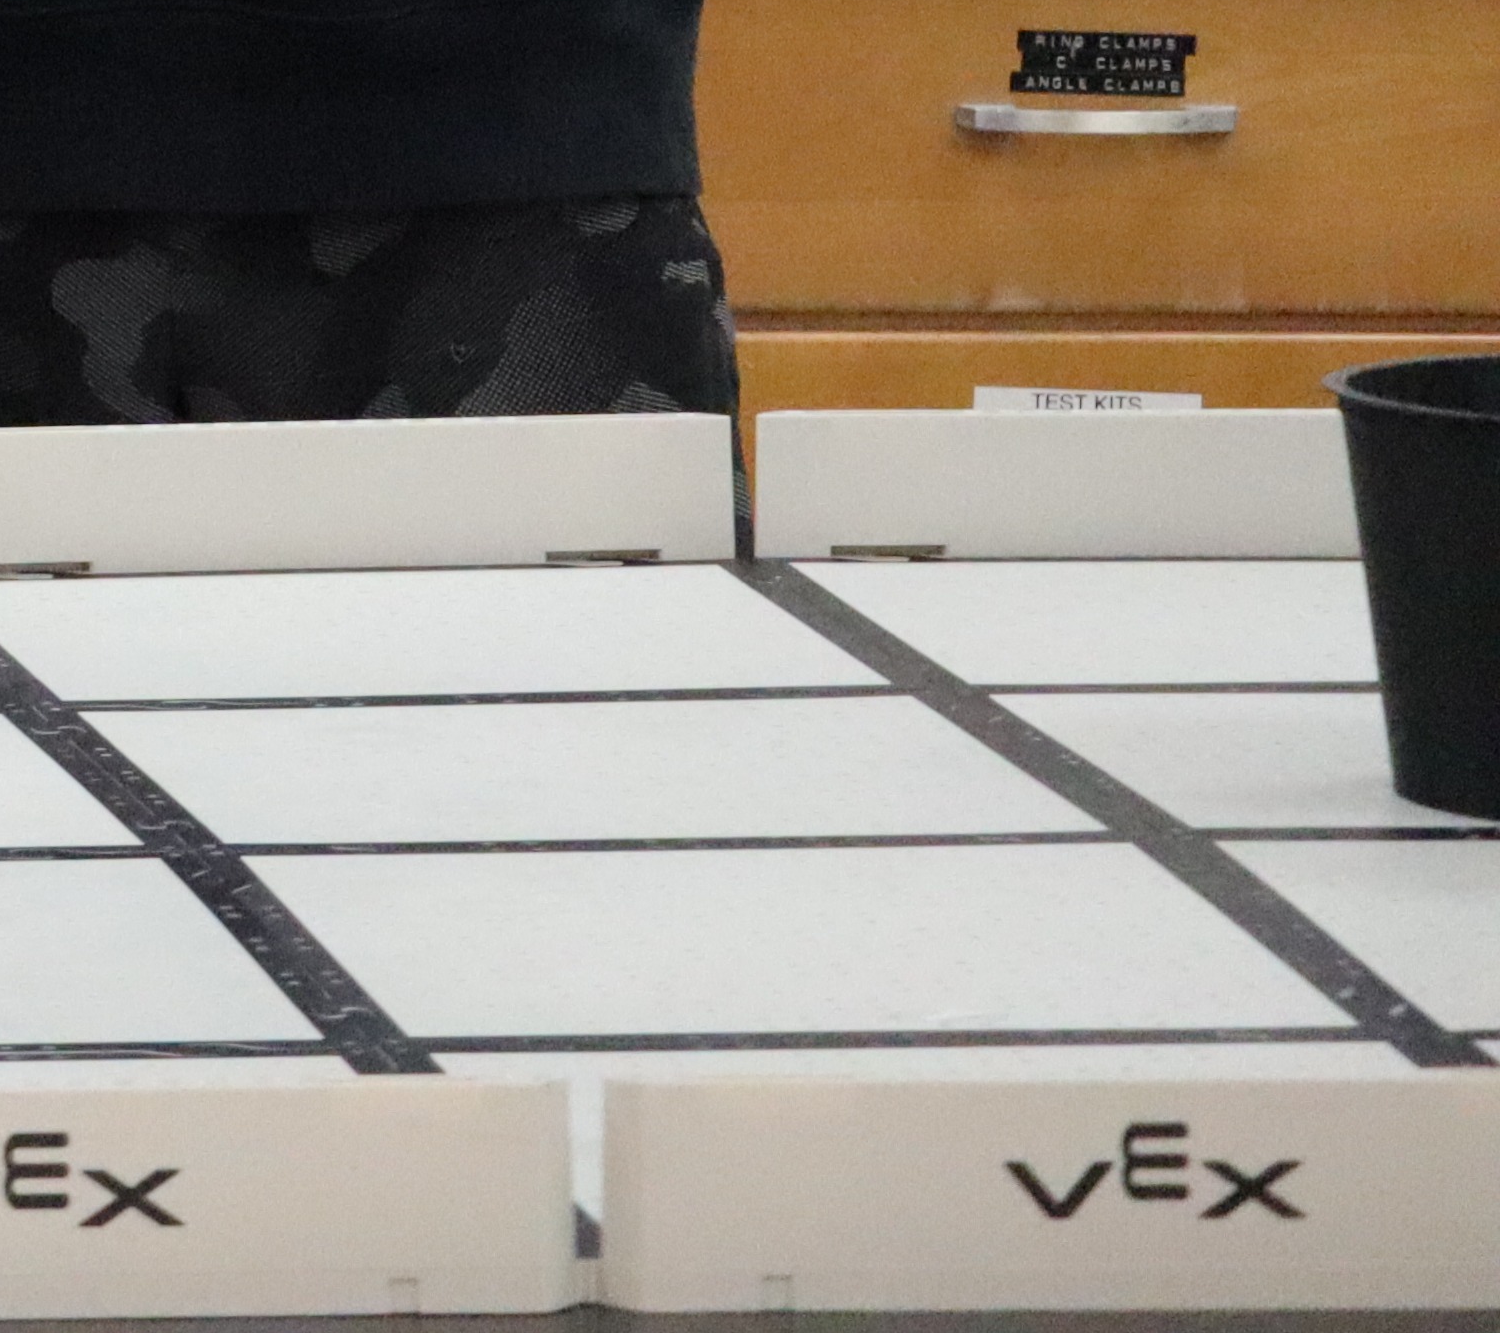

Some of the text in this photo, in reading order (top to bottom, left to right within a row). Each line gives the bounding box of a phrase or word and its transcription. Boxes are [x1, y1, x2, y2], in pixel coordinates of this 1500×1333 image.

[1034, 34, 1177, 51] RING CLAMPS
[1056, 56, 1172, 72] C CLAMPS
[1024, 75, 1181, 94] ANGLE CLAMPS
[1032, 392, 1143, 410] TEST KITS
[1007, 1123, 1301, 1220] VEX
